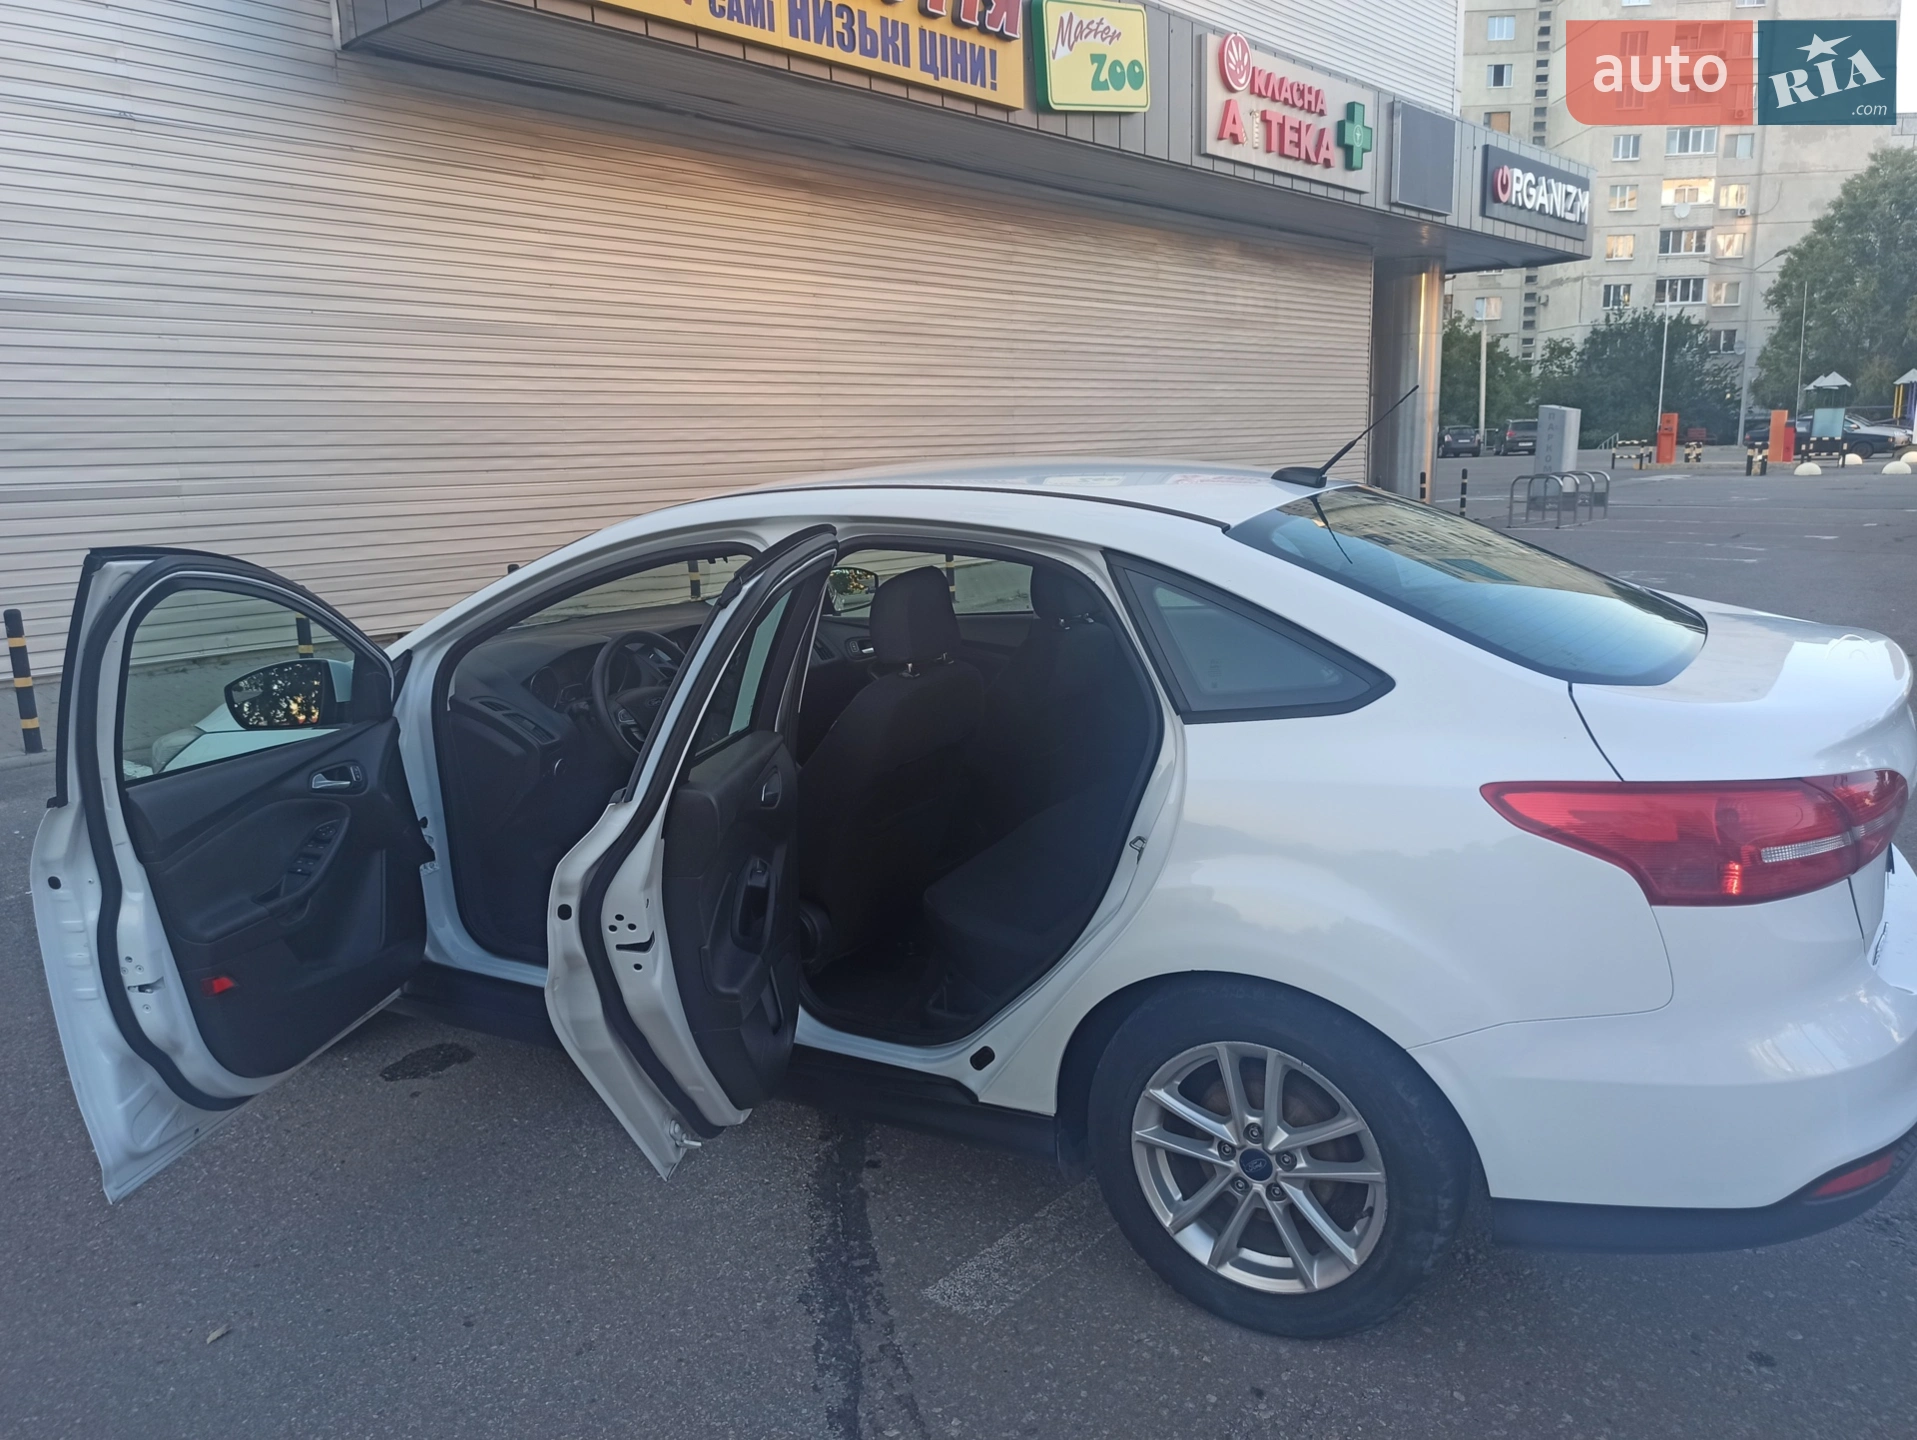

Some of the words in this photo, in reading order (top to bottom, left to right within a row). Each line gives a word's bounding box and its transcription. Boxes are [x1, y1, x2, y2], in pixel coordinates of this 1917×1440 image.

[788, 0, 911, 69] НИЗЬКІ
[918, 27, 998, 92] ЦІНИ!
[1052, 11, 1122, 60] Master
[1493, 165, 1590, 225] ORGANIZM
